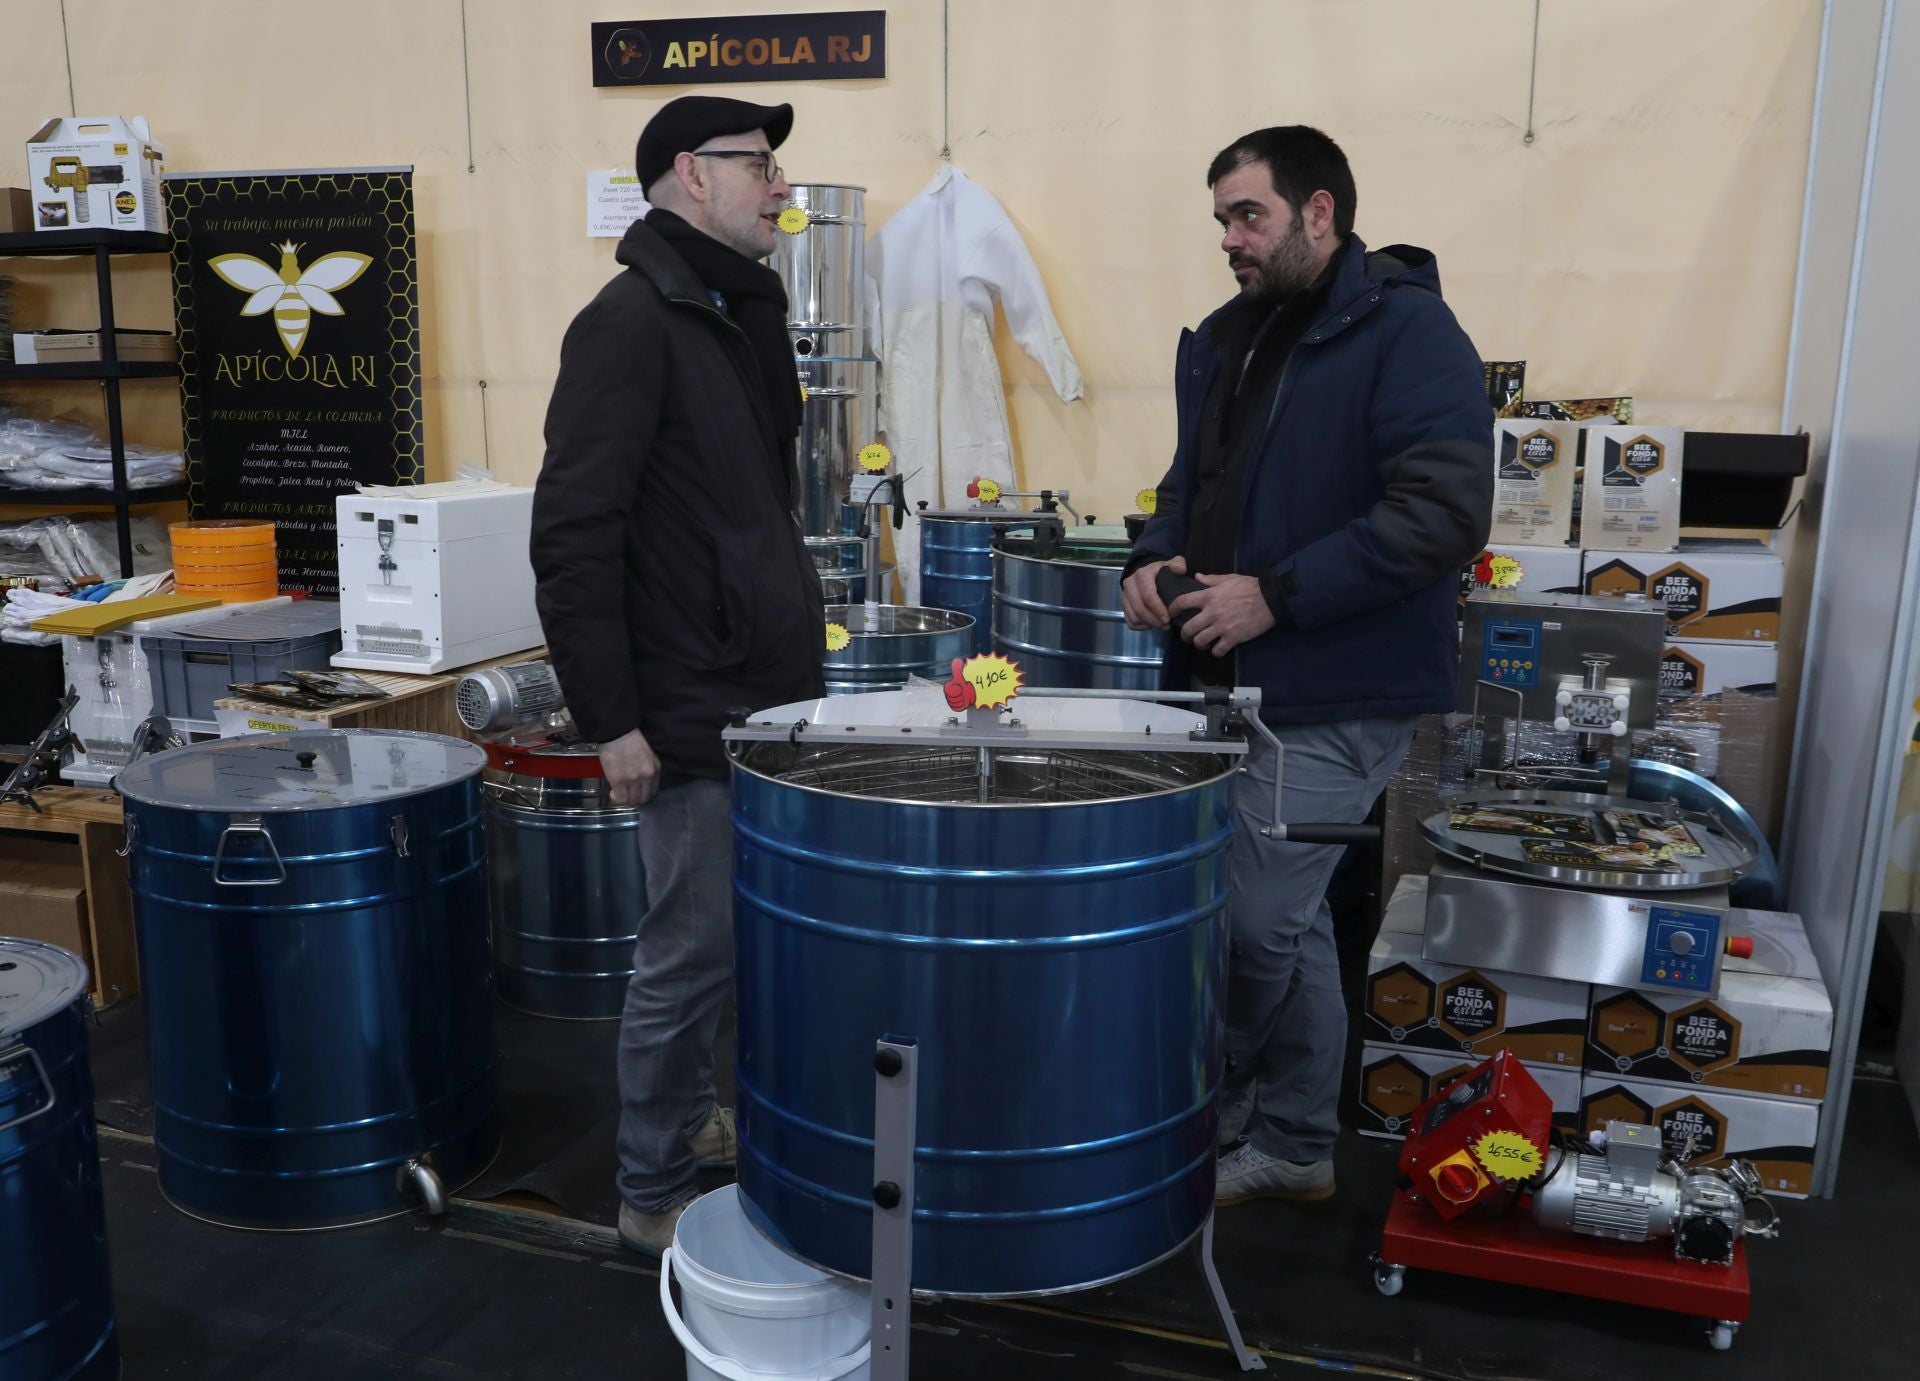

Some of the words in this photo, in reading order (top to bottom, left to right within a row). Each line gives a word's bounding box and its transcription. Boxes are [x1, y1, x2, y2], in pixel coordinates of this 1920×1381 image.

[662, 33, 816, 68] APÍCOLA
[827, 34, 872, 63] RJ
[203, 219, 219, 231] Su
[274, 216, 323, 230] nuestra
[327, 213, 372, 232] pasión
[214, 349, 349, 388] APÍCOLA
[351, 355, 377, 388] RJ
[210, 410, 281, 422] PRODUCTOS
[285, 411, 300, 421] DE
[304, 411, 322, 421] LA
[325, 411, 383, 422] COLMENA
[280, 429, 308, 439] MIEL
[247, 443, 280, 452] Azahar,
[316, 444, 351, 454] Romero,
[1523, 444, 1553, 452] FONDA
[242, 458, 280, 469] Eucalipto,
[283, 459, 309, 468] Brezo,
[311, 459, 352, 470] Montaña,
[240, 475, 275, 486] Propóleo,
[278, 476, 300, 487] Jalea
[304, 477, 324, 486] Real
[326, 479, 331, 488] y
[223, 503, 291, 513] PRODUCTOS
[310, 523, 316, 532] y
[1665, 576, 1689, 586] BEE
[308, 584, 313, 593] y
[1655, 586, 1698, 596] FONDA
[1662, 661, 1685, 670] BEE
[976, 669, 1007, 689] 410€
[1660, 671, 1693, 681] ONDA
[247, 719, 277, 731] OFERTA
[1457, 987, 1484, 999] BEE
[1446, 995, 1494, 1010] FONDA
[1453, 1006, 1485, 1016] extra
[1689, 1015, 1717, 1029] BEE
[1676, 1025, 1727, 1041] FONDA
[1683, 1036, 1716, 1047] extra
[1675, 1111, 1704, 1123] BEE
[1663, 1120, 1713, 1136] FONDA
[1488, 1142, 1532, 1163] 1655€
